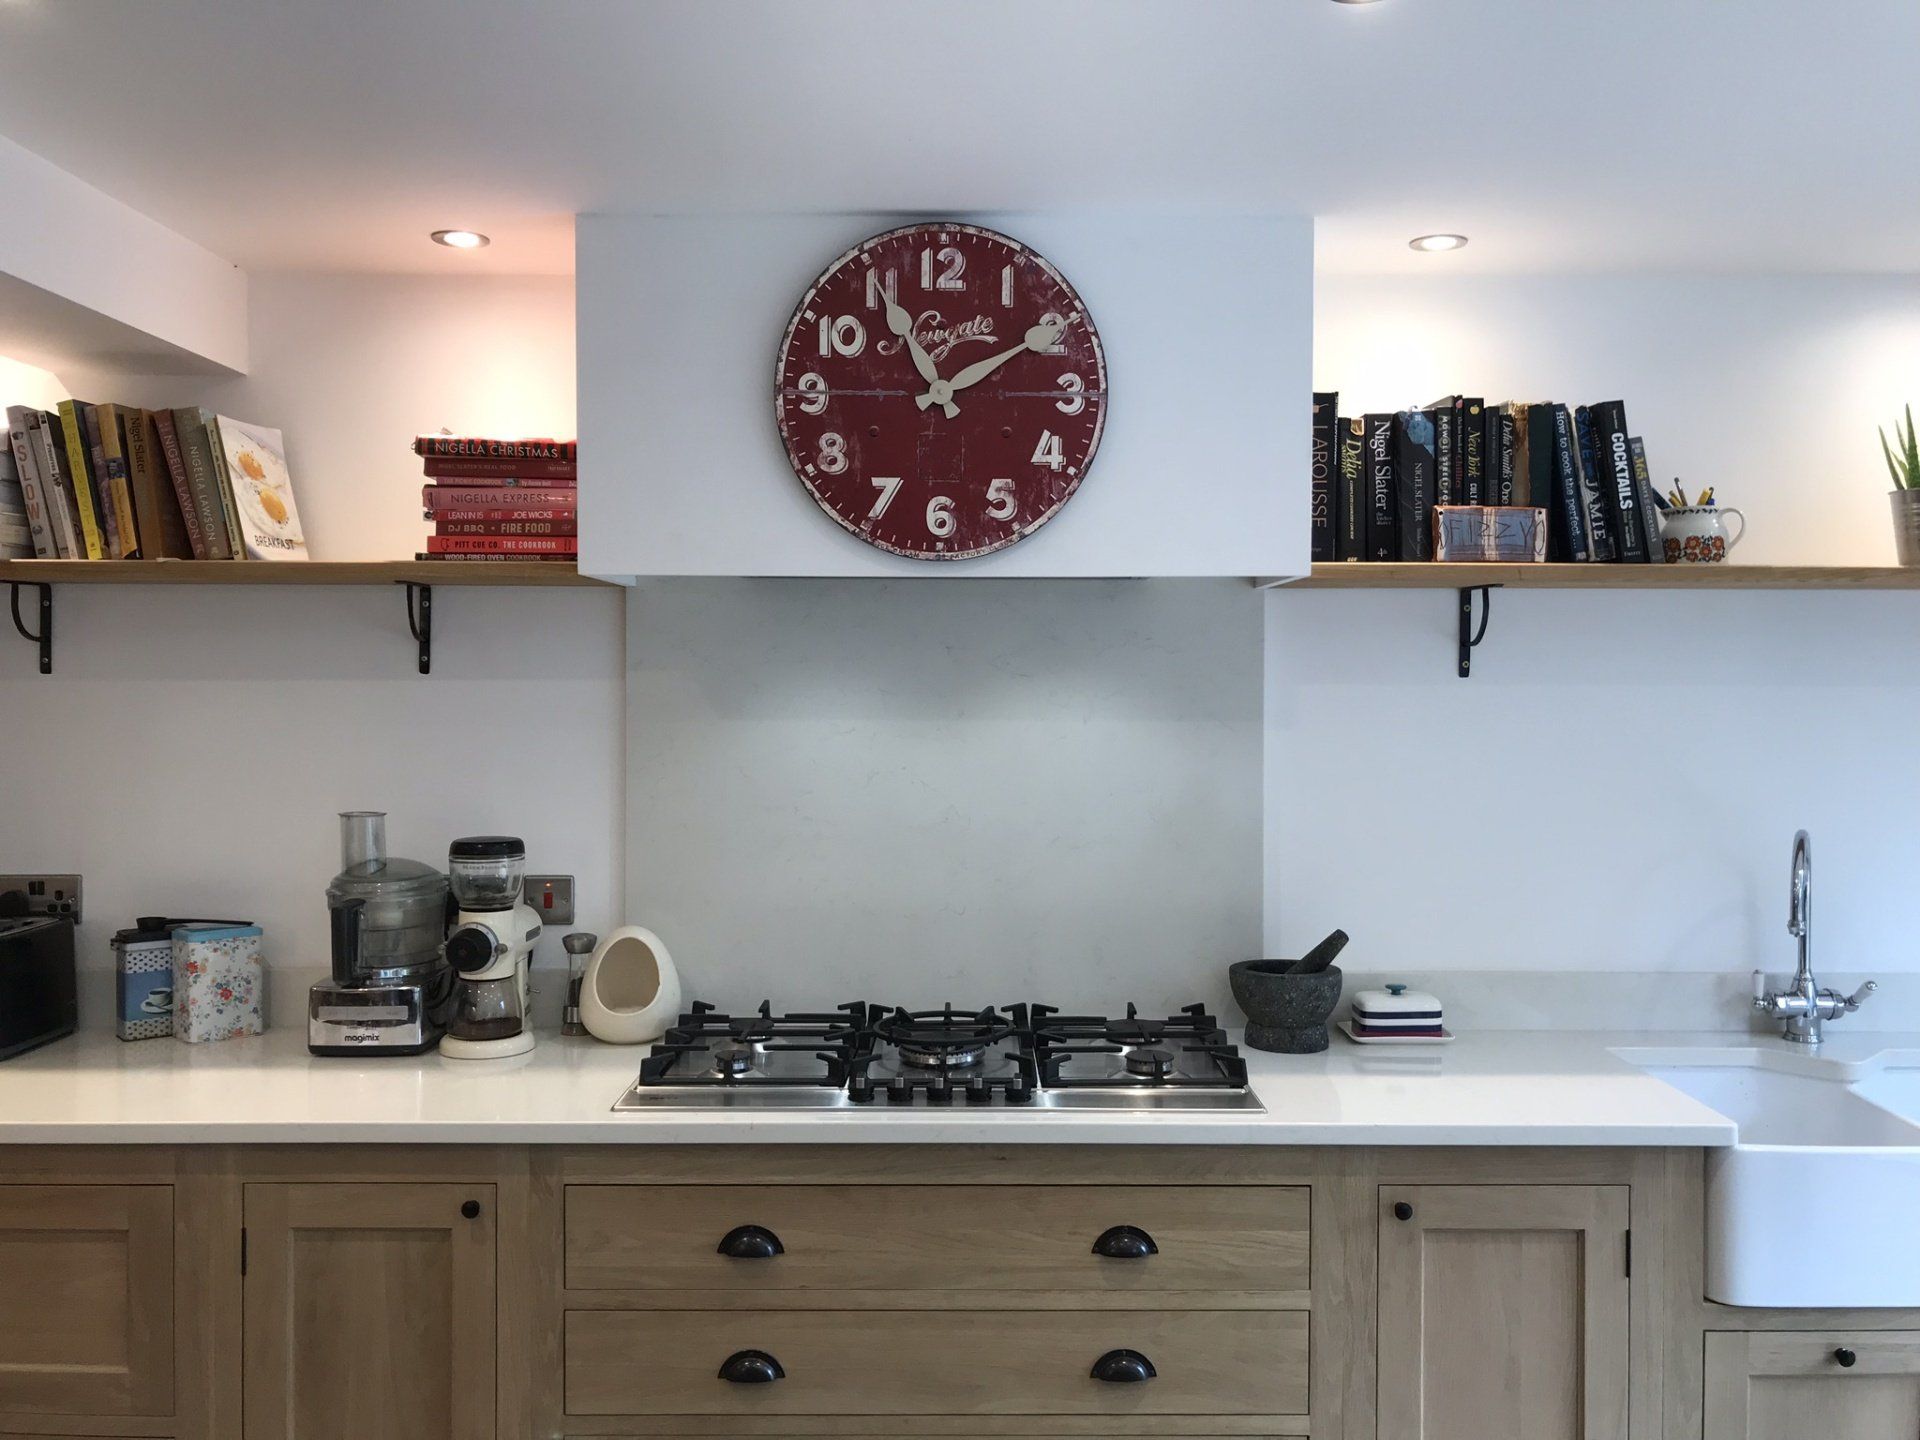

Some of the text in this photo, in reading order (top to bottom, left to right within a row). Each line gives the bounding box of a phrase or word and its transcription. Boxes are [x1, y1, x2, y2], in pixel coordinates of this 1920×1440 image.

[866, 267, 898, 310] 11
[921, 247, 966, 291] 12
[1002, 264, 1014, 308] 1
[819, 314, 867, 358] 10
[1039, 312, 1067, 356] 2
[798, 372, 829, 415] 9
[1055, 372, 1085, 415] 3
[1369, 420, 1391, 462] Nigel
[1468, 427, 1480, 454] New
[1556, 411, 1565, 434] How
[1559, 437, 1567, 448] to
[130, 417, 146, 474] Nigel Slater
[435, 443, 558, 458] NIGELLA CHRISTMAS
[817, 432, 849, 475] 8
[1030, 429, 1066, 471] 4
[1346, 439, 1362, 479] Delia
[1468, 455, 1480, 477] York
[1502, 420, 1513, 504] Delia Smith's One
[1561, 451, 1571, 475] cook
[18, 444, 40, 520] SLOW
[163, 433, 200, 540] NIGELLA LAWSON
[1312, 425, 1328, 528] LAROUSSE
[1374, 465, 1391, 510] Slater
[1414, 463, 1422, 490] NIGEL
[1565, 478, 1574, 495] the
[1577, 412, 1592, 459] SAVE
[1586, 478, 1606, 540] JAMIE
[1611, 432, 1633, 510] COCKTAILS
[190, 445, 216, 541] NIGELLA LAWSON
[451, 494, 550, 504] NIGELLA EXPRESS
[868, 477, 904, 520] 7
[985, 478, 1018, 522] 5
[1414, 491, 1422, 521] SLATER
[1634, 456, 1648, 480] 365
[1641, 481, 1649, 499] DAYS
[1646, 506, 1657, 542] COCKTAILS
[448, 511, 467, 519] LEAN
[512, 511, 527, 519] JOE
[528, 511, 552, 519] WICKS
[448, 523, 551, 533] DJ BBQ FIRE FOOD
[925, 495, 956, 538] 6
[254, 535, 295, 550] BREAKFAST
[472, 541, 486, 549] CUE
[503, 541, 516, 549] THE
[518, 541, 556, 549] COOKBOOK
[344, 1033, 379, 1043] magimix
